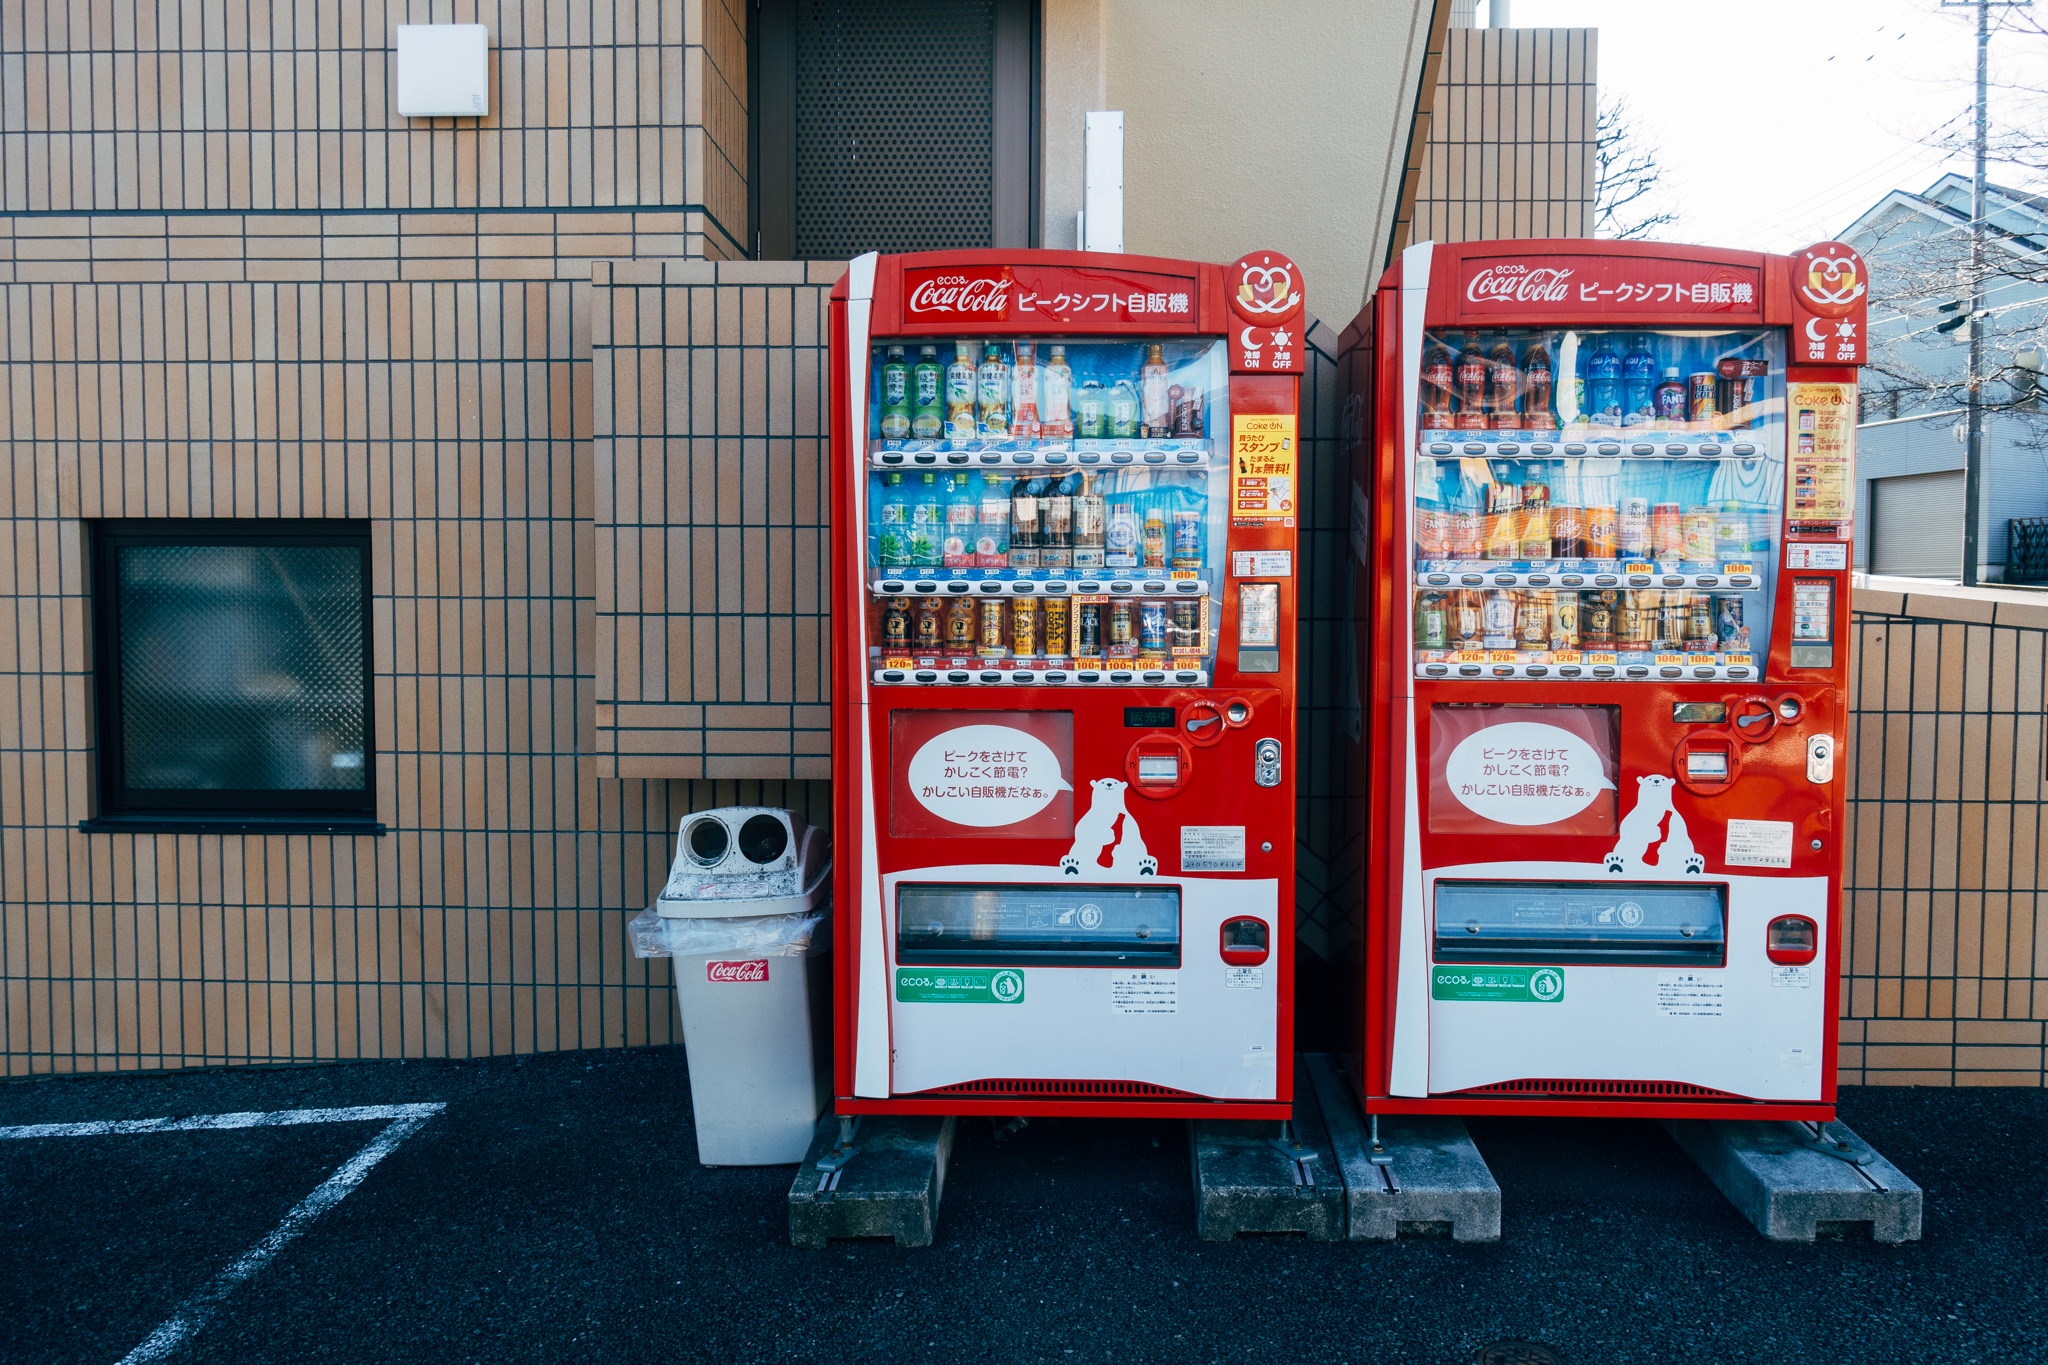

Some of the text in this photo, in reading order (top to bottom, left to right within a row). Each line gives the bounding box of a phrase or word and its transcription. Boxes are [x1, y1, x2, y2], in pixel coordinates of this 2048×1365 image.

[1466, 268, 1753, 304] Coca-Cola ピークシフト自販機
[910, 278, 1189, 314] Coca-Cola ピークシフト自販機
[1809, 350, 1825, 360] ON
[1836, 352, 1857, 361] OFF
[1244, 359, 1260, 368] ON
[1272, 360, 1292, 369] OFF
[1793, 394, 1828, 406] Coke
[1246, 422, 1269, 430] Coke
[1239, 434, 1265, 442] 買うたび
[1238, 442, 1280, 453] スタンプ
[1249, 455, 1275, 463] たまると
[1249, 463, 1290, 474] 1本無料!
[1628, 564, 1652, 572] 100円
[1726, 564, 1750, 573] 100円
[1172, 571, 1197, 579] 100円
[1022, 610, 1032, 639] MAX
[1054, 611, 1064, 641] MAX
[1081, 617, 1099, 627] LACK
[1460, 654, 1485, 662] 120円
[1492, 654, 1516, 662] 120円
[1555, 655, 1580, 663] 120円
[1657, 655, 1681, 663] 100円
[1727, 655, 1750, 663] 110円
[888, 660, 912, 668] 120円
[1108, 662, 1132, 670] 100円
[1175, 662, 1199, 670] 100円
[944, 750, 1028, 763] ピークをさけて
[1483, 747, 1569, 761] ピークをさけて
[944, 766, 1028, 779] かしこく節電?
[1483, 763, 1569, 777] かしこく節電?
[922, 786, 1049, 799] かしこい自販機だなぁ。
[1461, 783, 1591, 797] かしこい自販機だなぁ。
[710, 962, 767, 981] Coca-Cola
